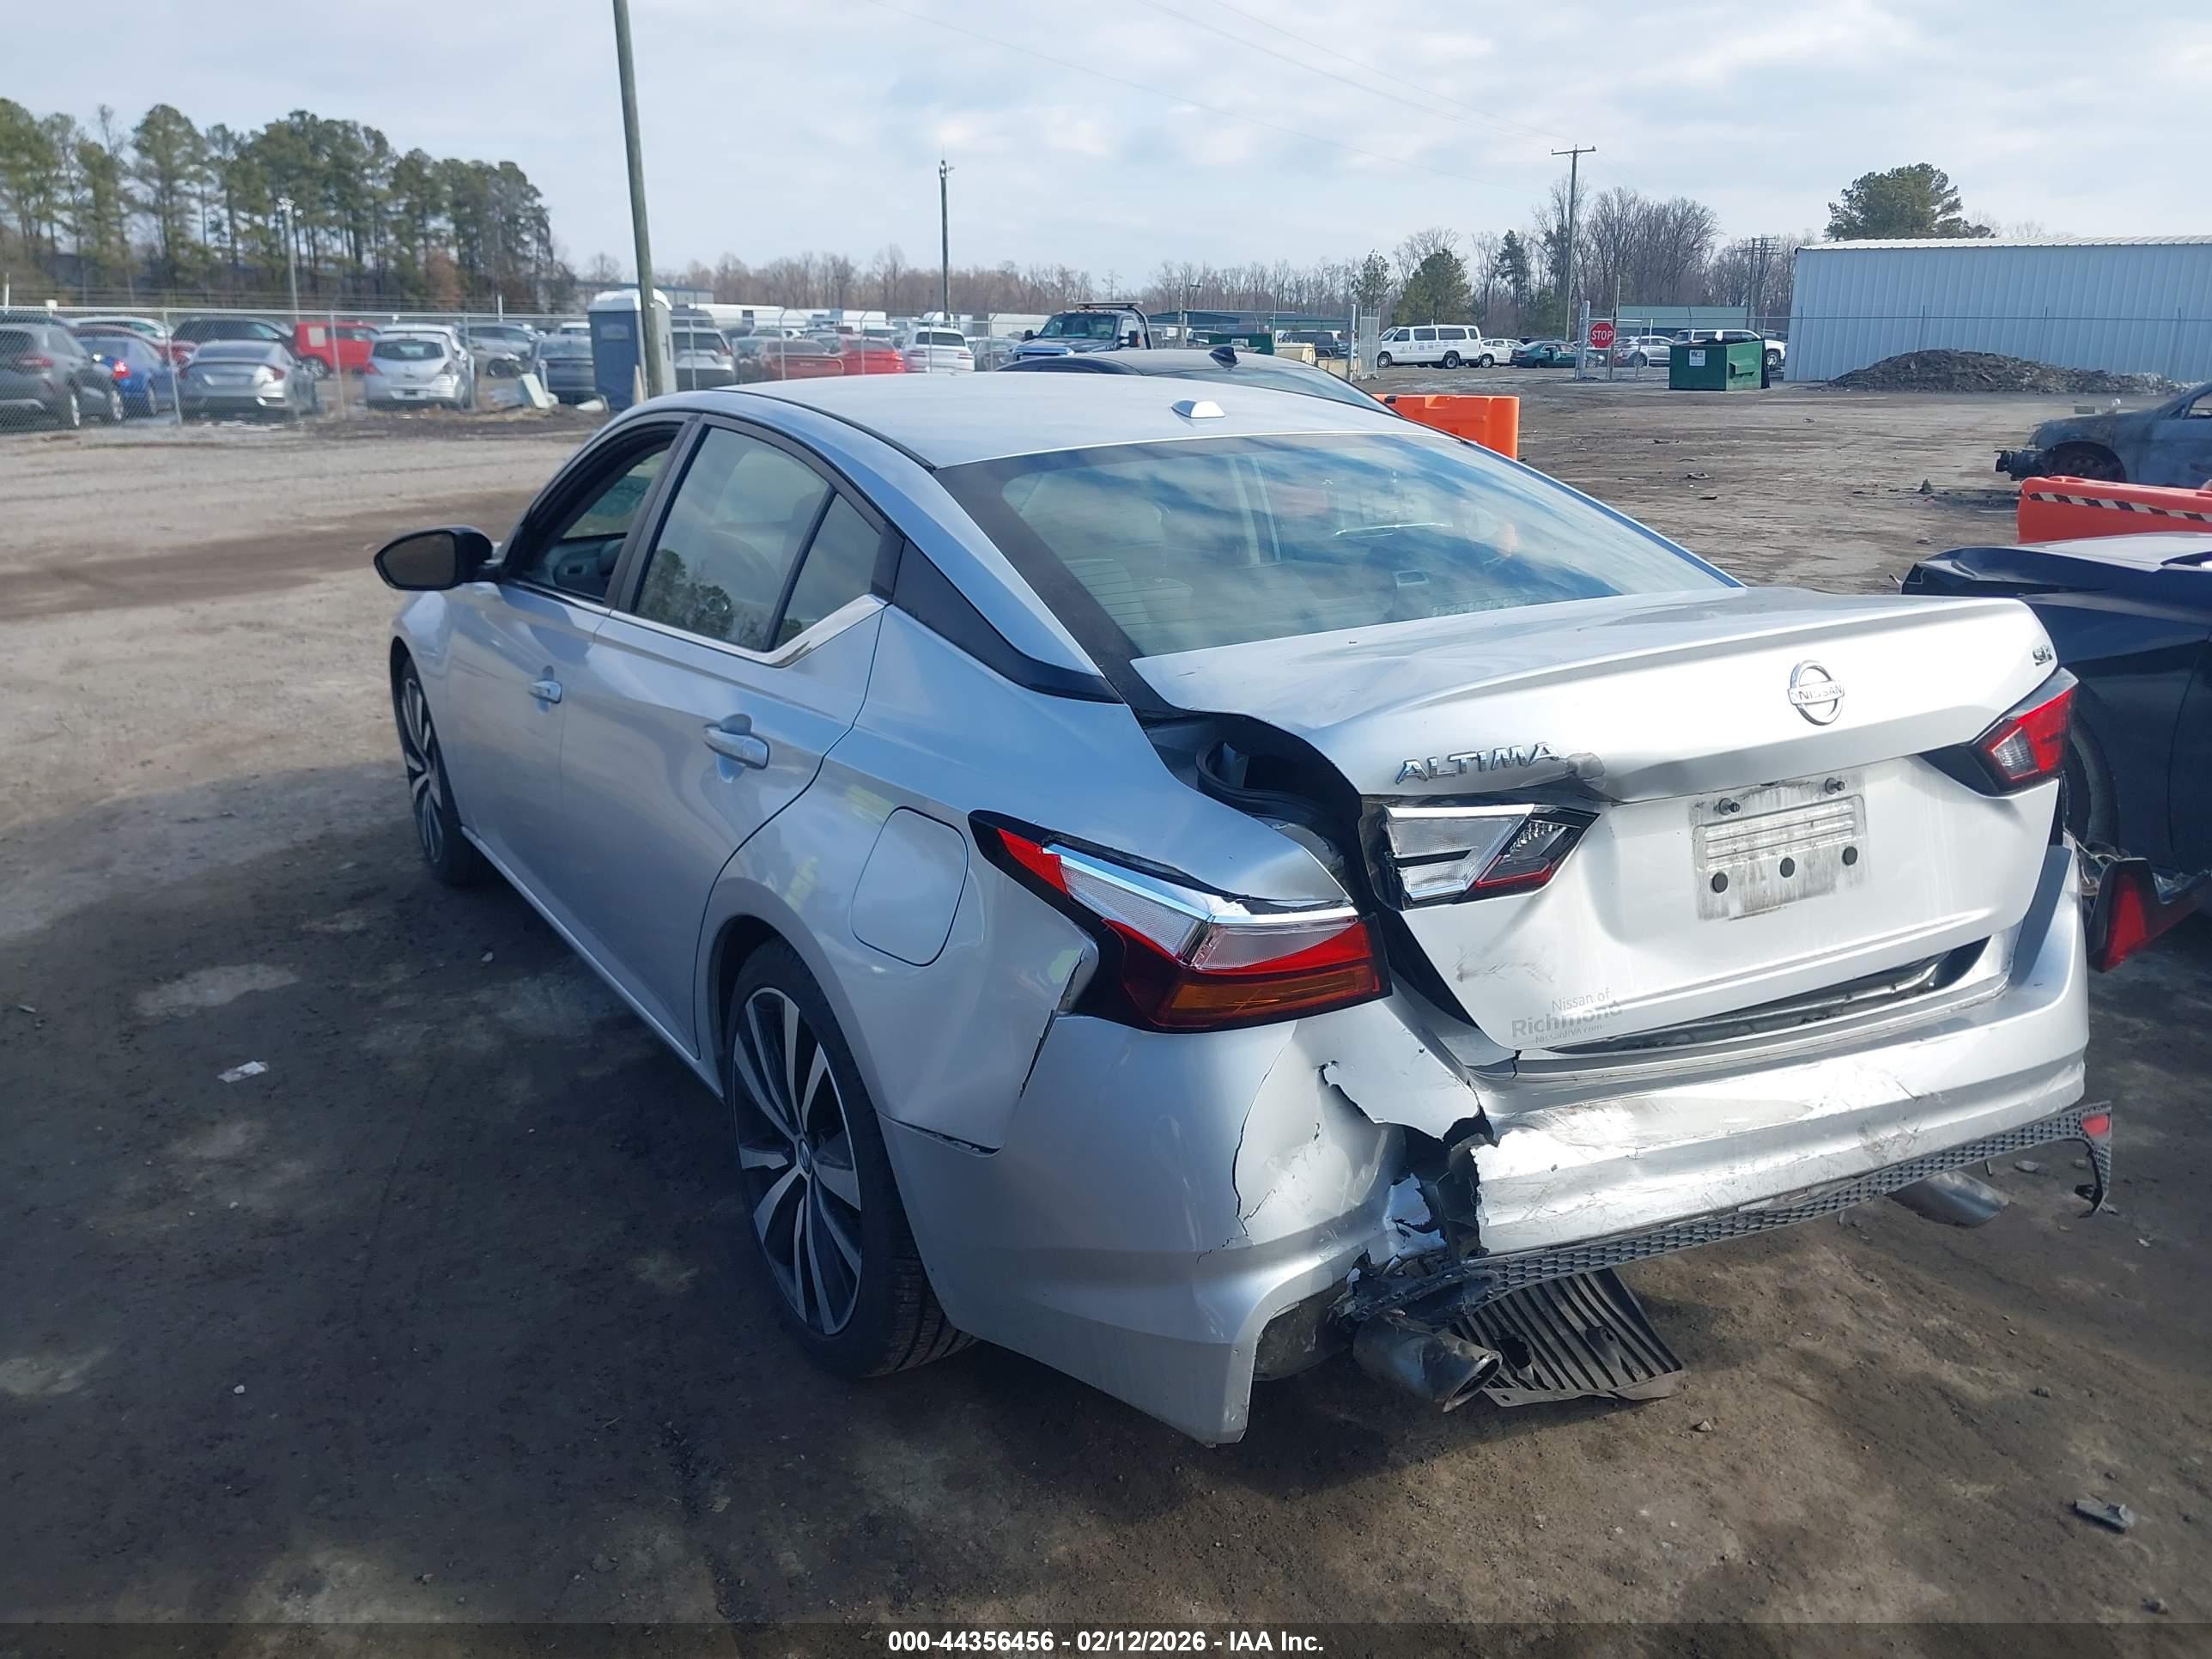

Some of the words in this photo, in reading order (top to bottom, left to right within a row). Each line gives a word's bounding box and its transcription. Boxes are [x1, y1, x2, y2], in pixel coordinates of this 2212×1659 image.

[1591, 330, 1613, 341] STOP
[1798, 684, 1843, 700] NISSAN
[1395, 742, 1560, 784] ALTIMA
[1552, 994, 1593, 1013] Nissan
[1597, 987, 1610, 1002] of
